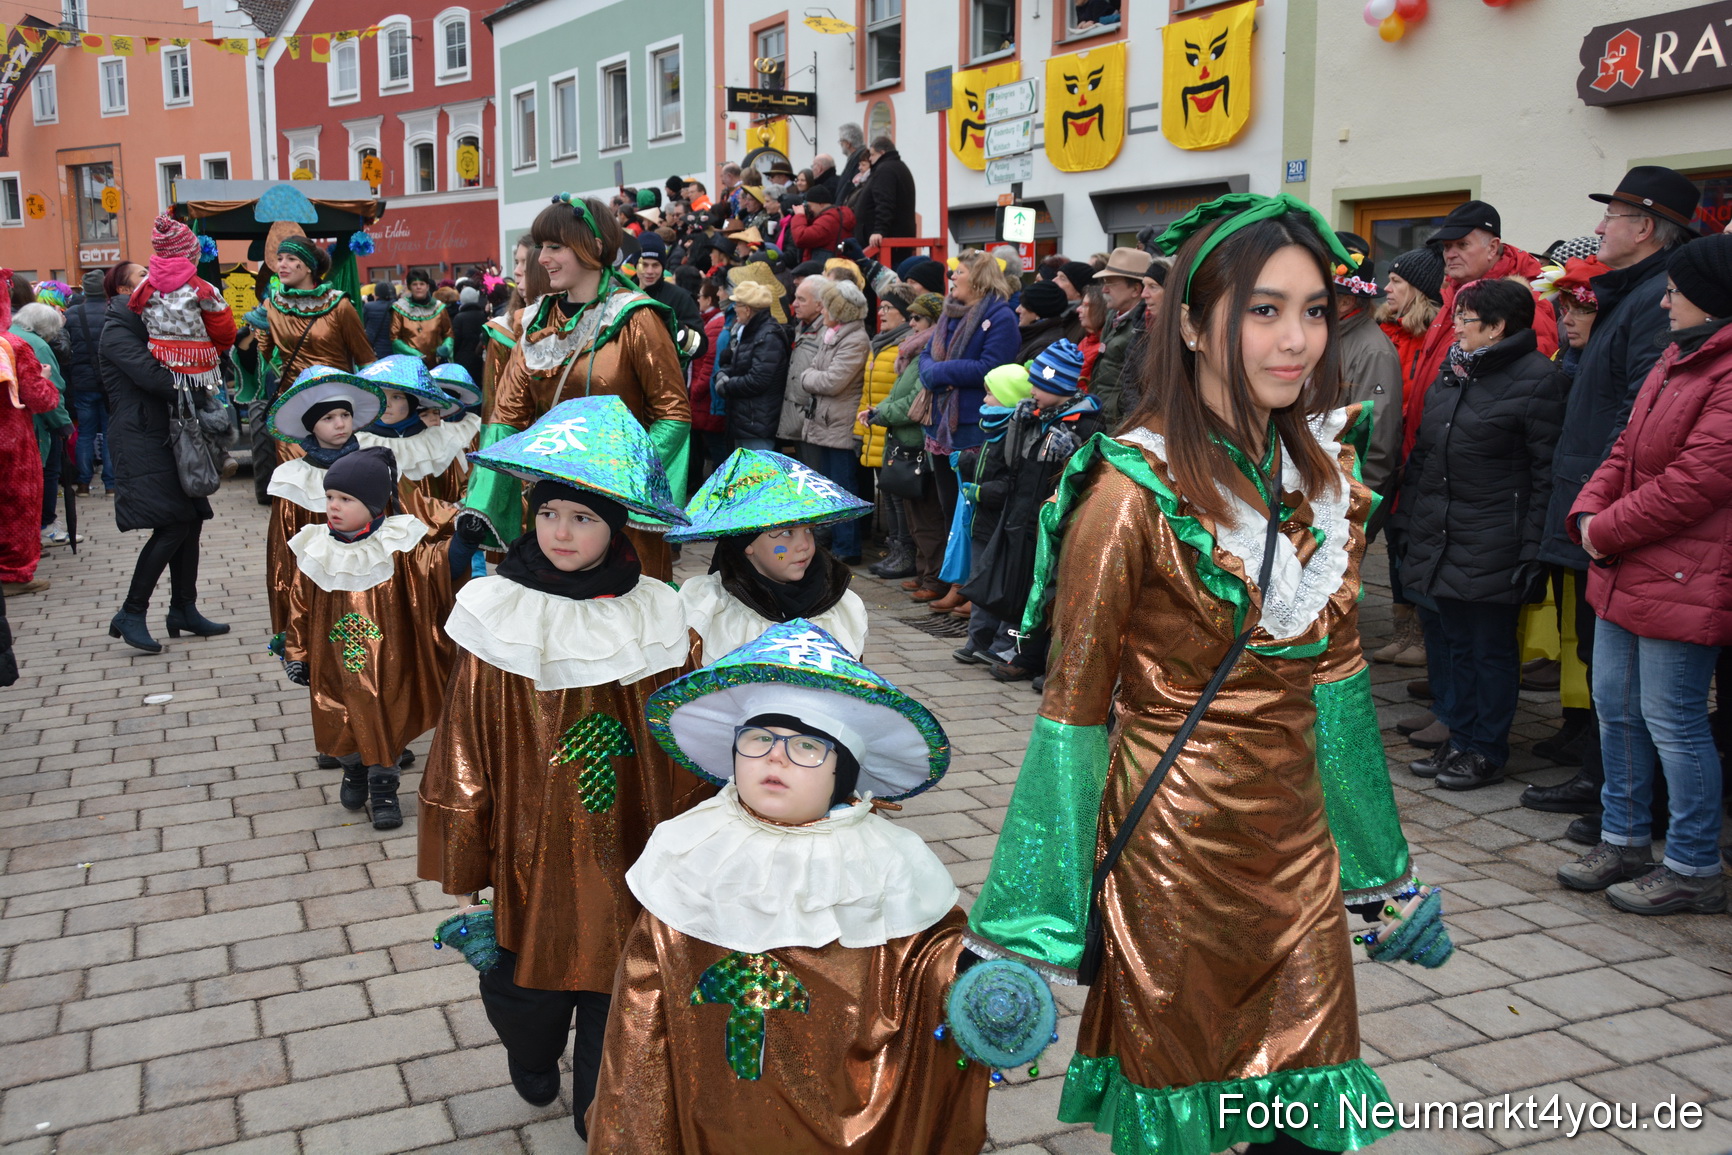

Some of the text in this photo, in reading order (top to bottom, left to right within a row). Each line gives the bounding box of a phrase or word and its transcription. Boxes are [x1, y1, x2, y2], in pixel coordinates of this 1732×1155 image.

[1650, 19, 1732, 79] RA
[736, 91, 807, 106] RÖHLICH
[1289, 161, 1303, 174] 20
[385, 219, 411, 239] Erlebnis
[425, 219, 469, 251] Erlebnis
[80, 248, 120, 262] GÖTZ
[755, 630, 857, 671] 香
